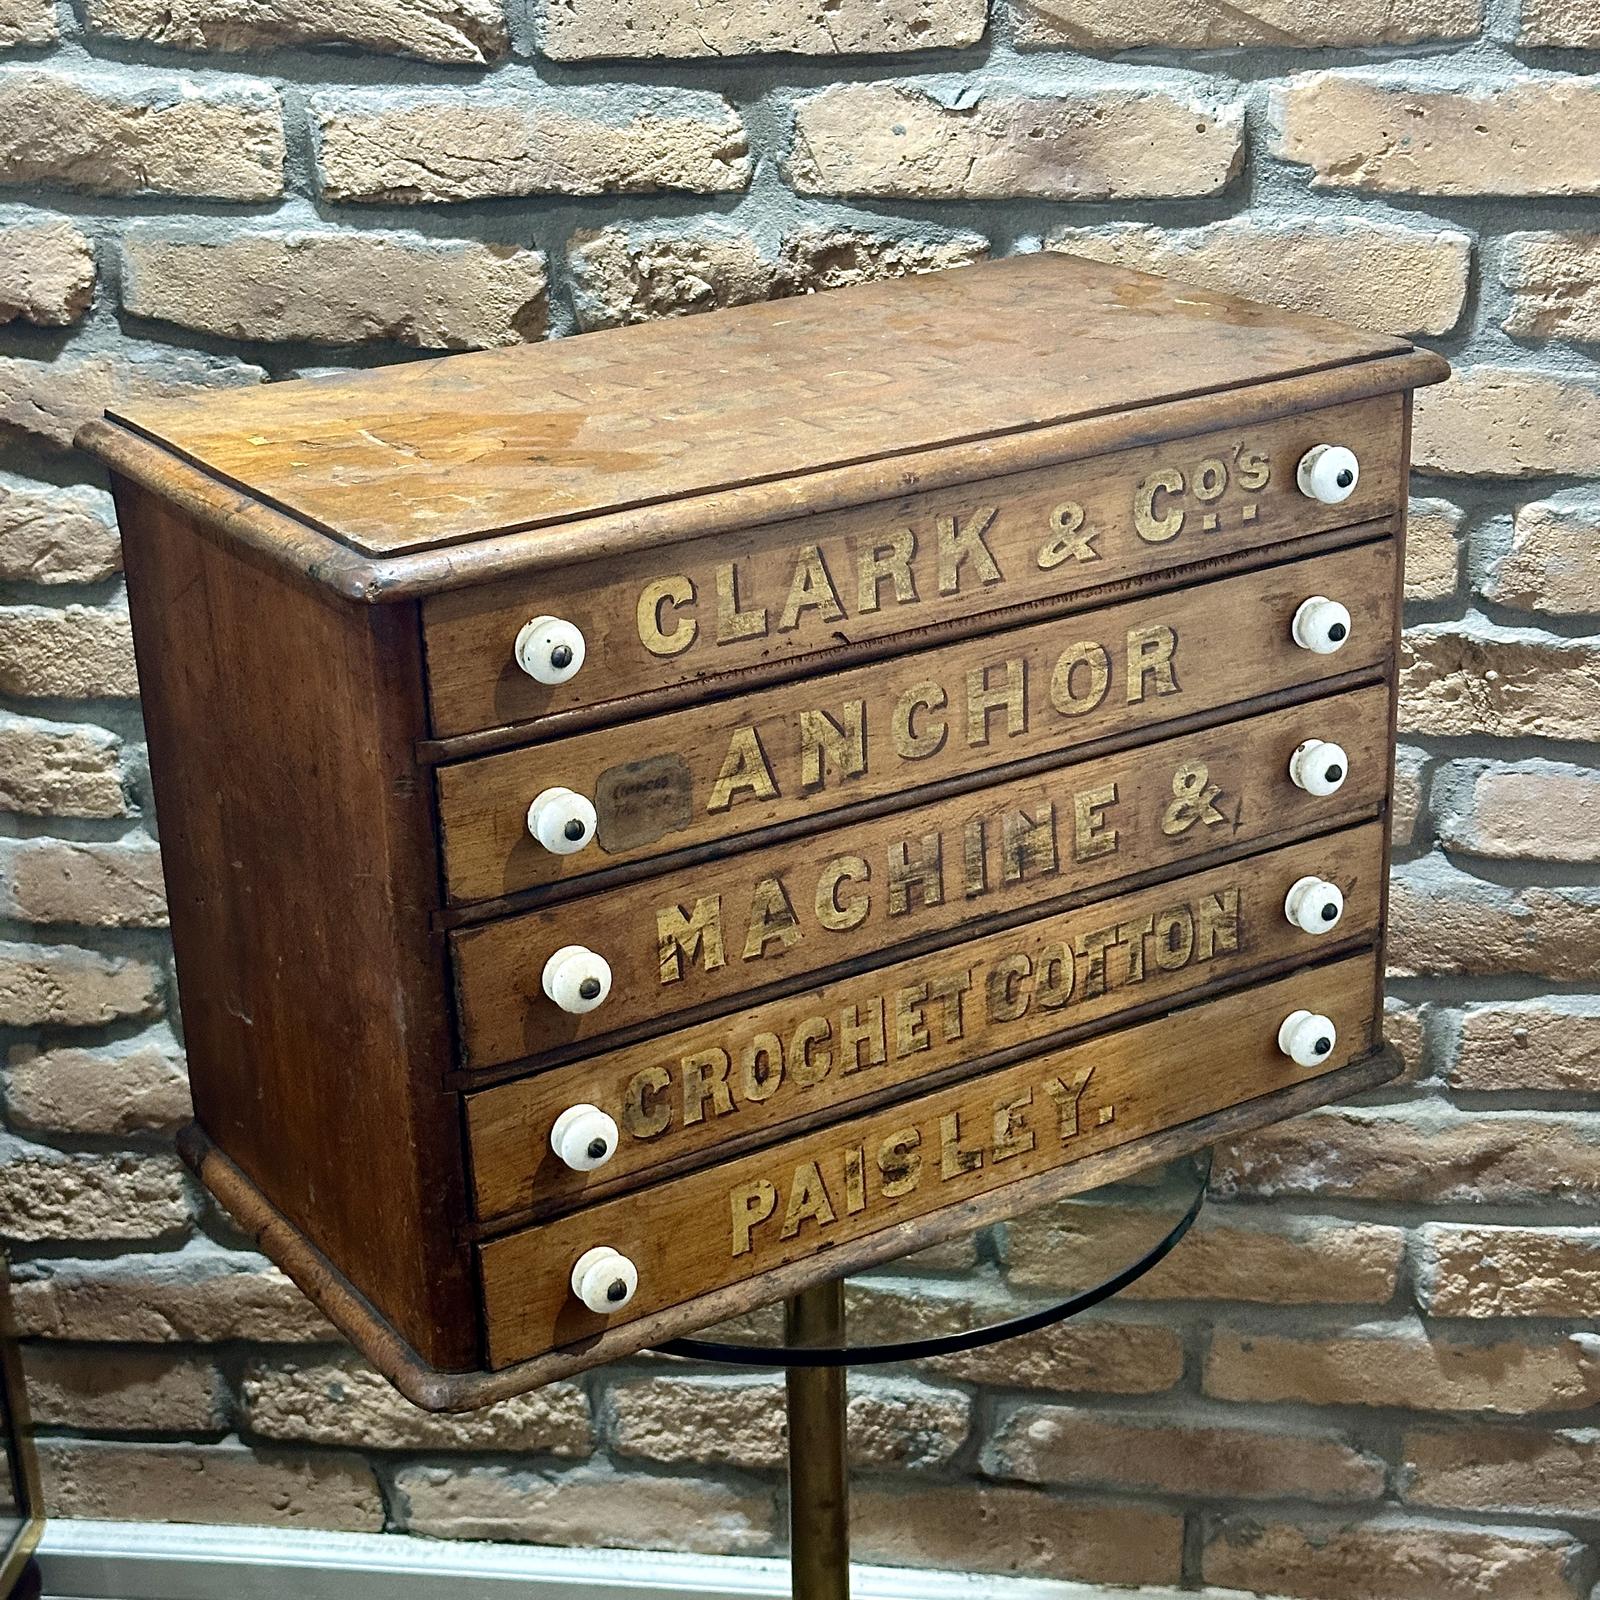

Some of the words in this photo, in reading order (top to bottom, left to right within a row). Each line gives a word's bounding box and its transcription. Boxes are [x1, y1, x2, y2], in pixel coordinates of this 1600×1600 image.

[635, 506, 1002, 659] CLARK
[1037, 501, 1101, 570] &
[706, 624, 1181, 813] ANCHOR
[656, 783, 1120, 984] MACHINE
[1161, 758, 1225, 836] &
[622, 967, 973, 1139] CROCHET
[985, 888, 1241, 1024] COTTON
